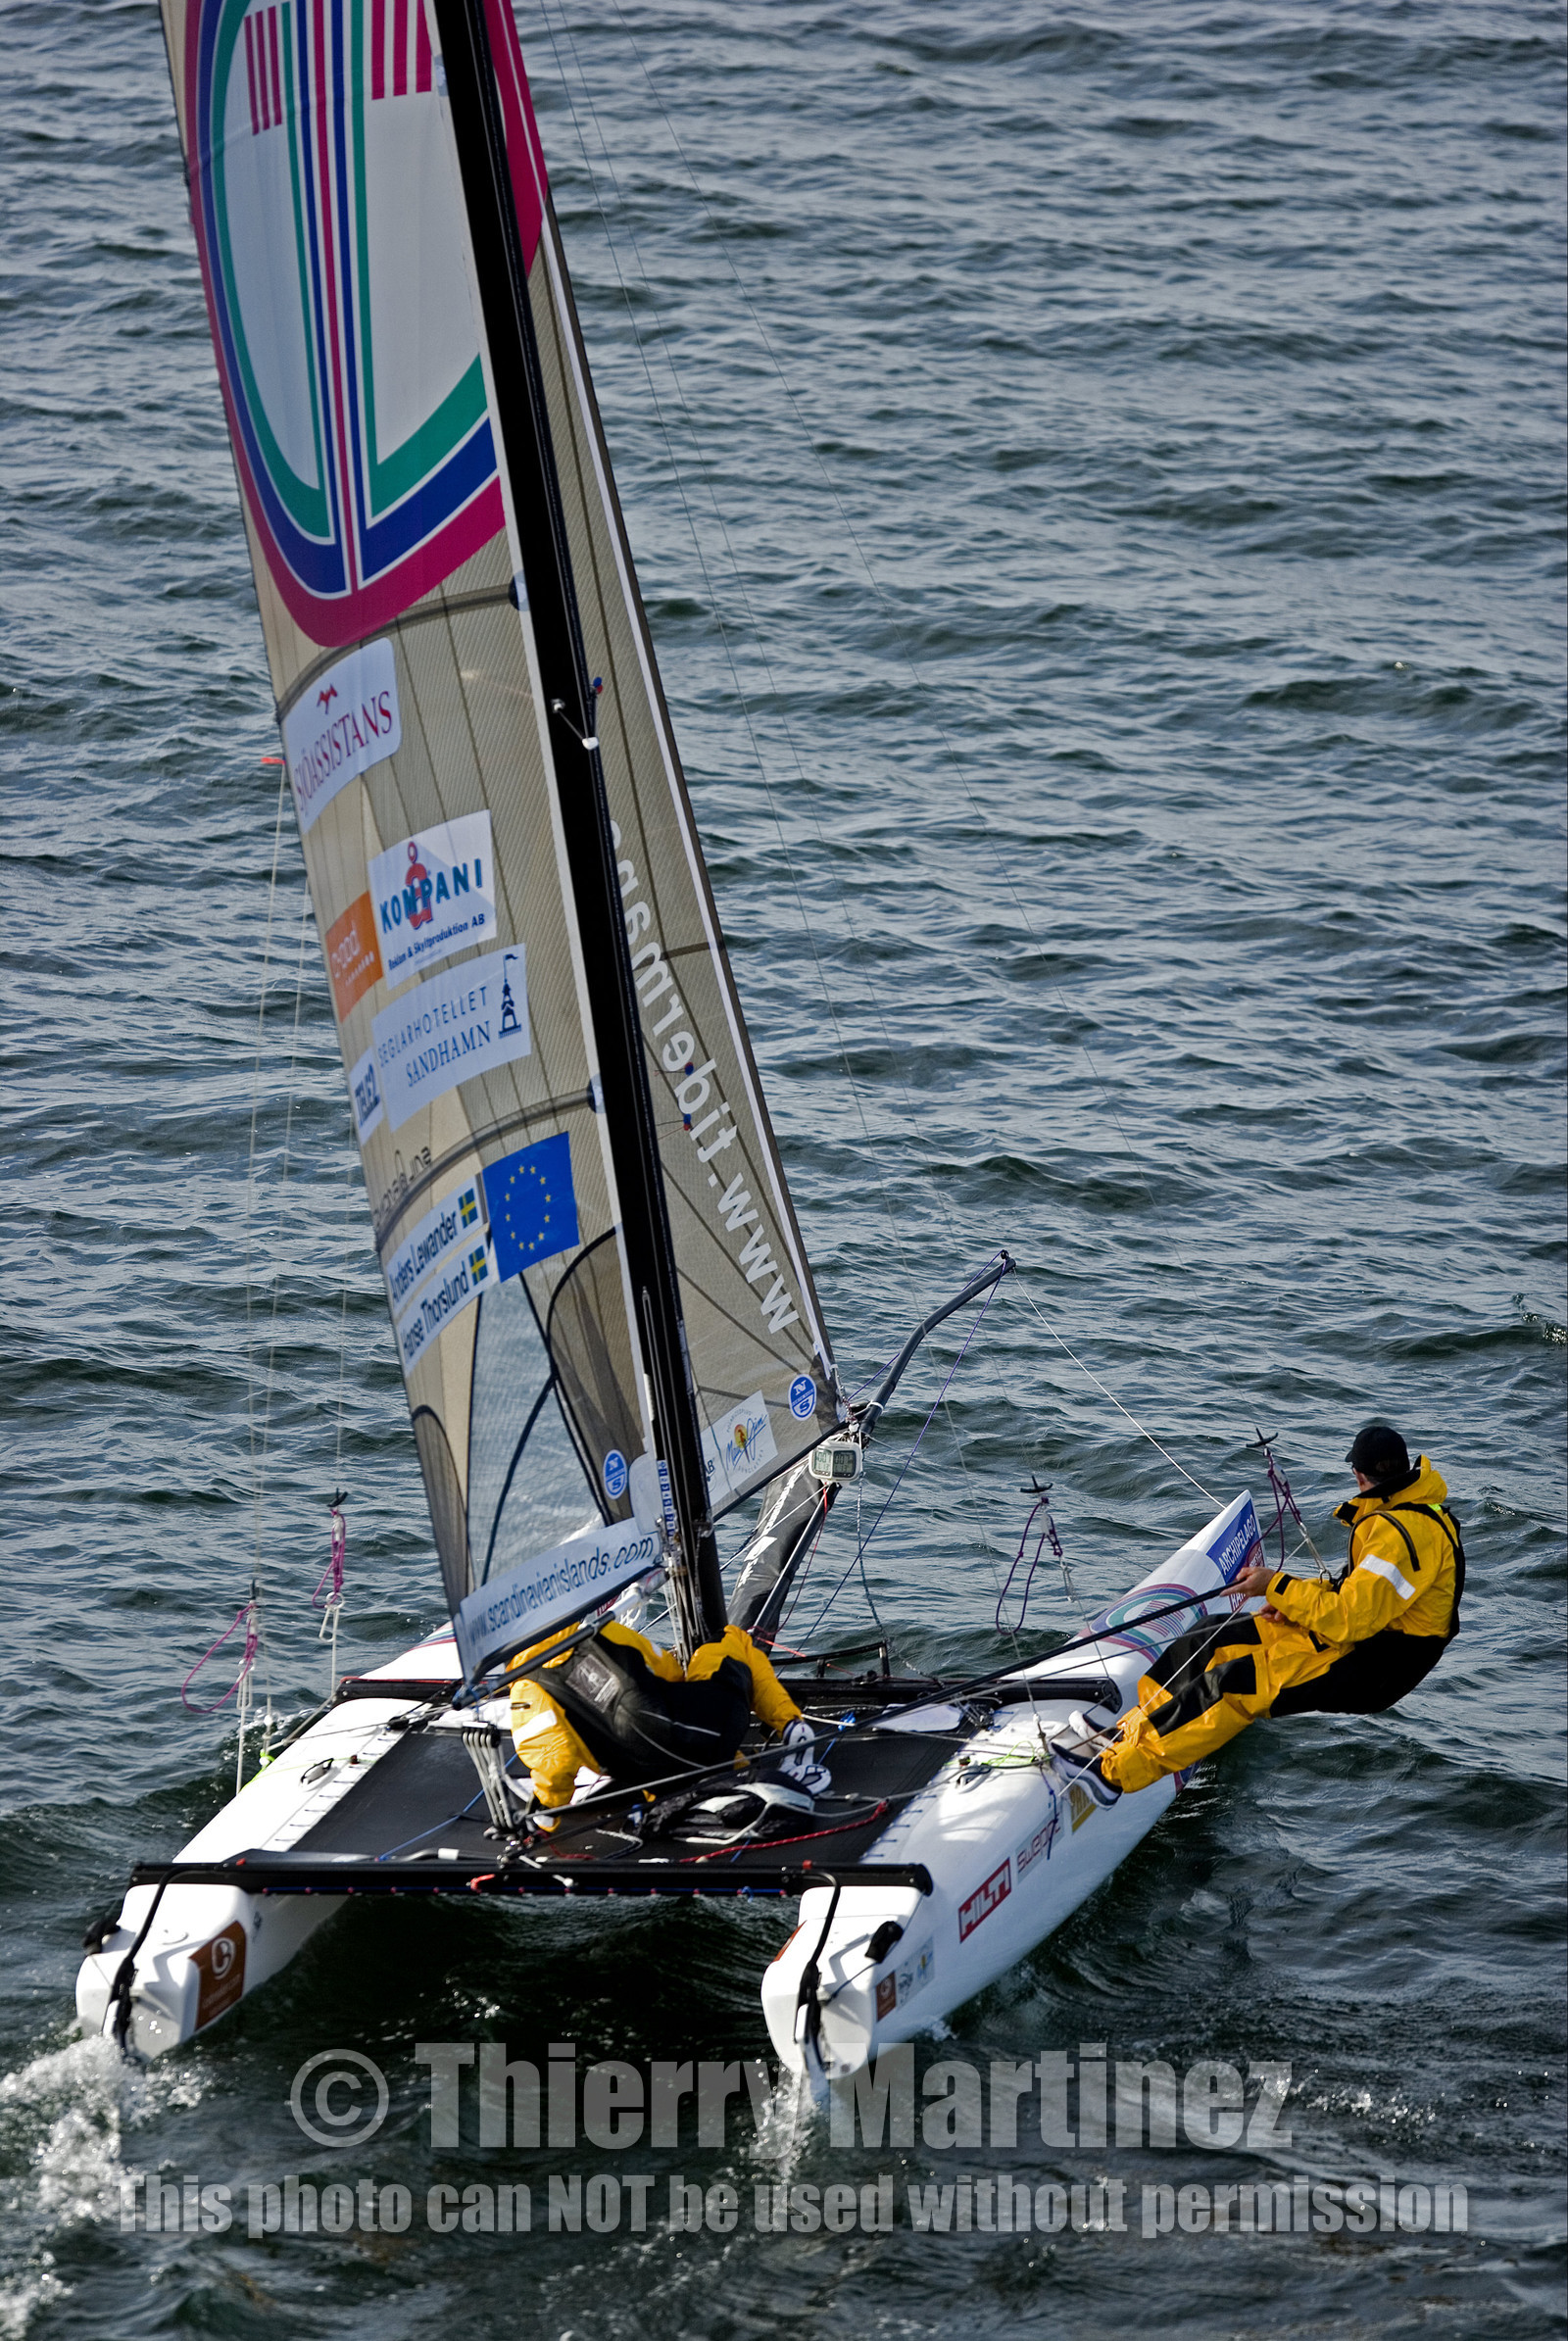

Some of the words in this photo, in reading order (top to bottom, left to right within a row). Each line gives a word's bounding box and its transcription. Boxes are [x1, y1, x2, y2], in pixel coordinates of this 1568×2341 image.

[379, 858, 482, 934] KOMPANI
[471, 913, 485, 928] AB
[406, 1020, 491, 1088] SANDHAMN
[411, 1211, 458, 1275] Lewander
[793, 1380, 807, 1396] N
[799, 1399, 810, 1413] S
[612, 1477, 622, 1490] S
[1218, 1514, 1256, 1576] ARCHIPELAGO
[470, 1536, 654, 1645] www.scandinavianislands.com
[960, 1864, 1010, 1936] HILTI
